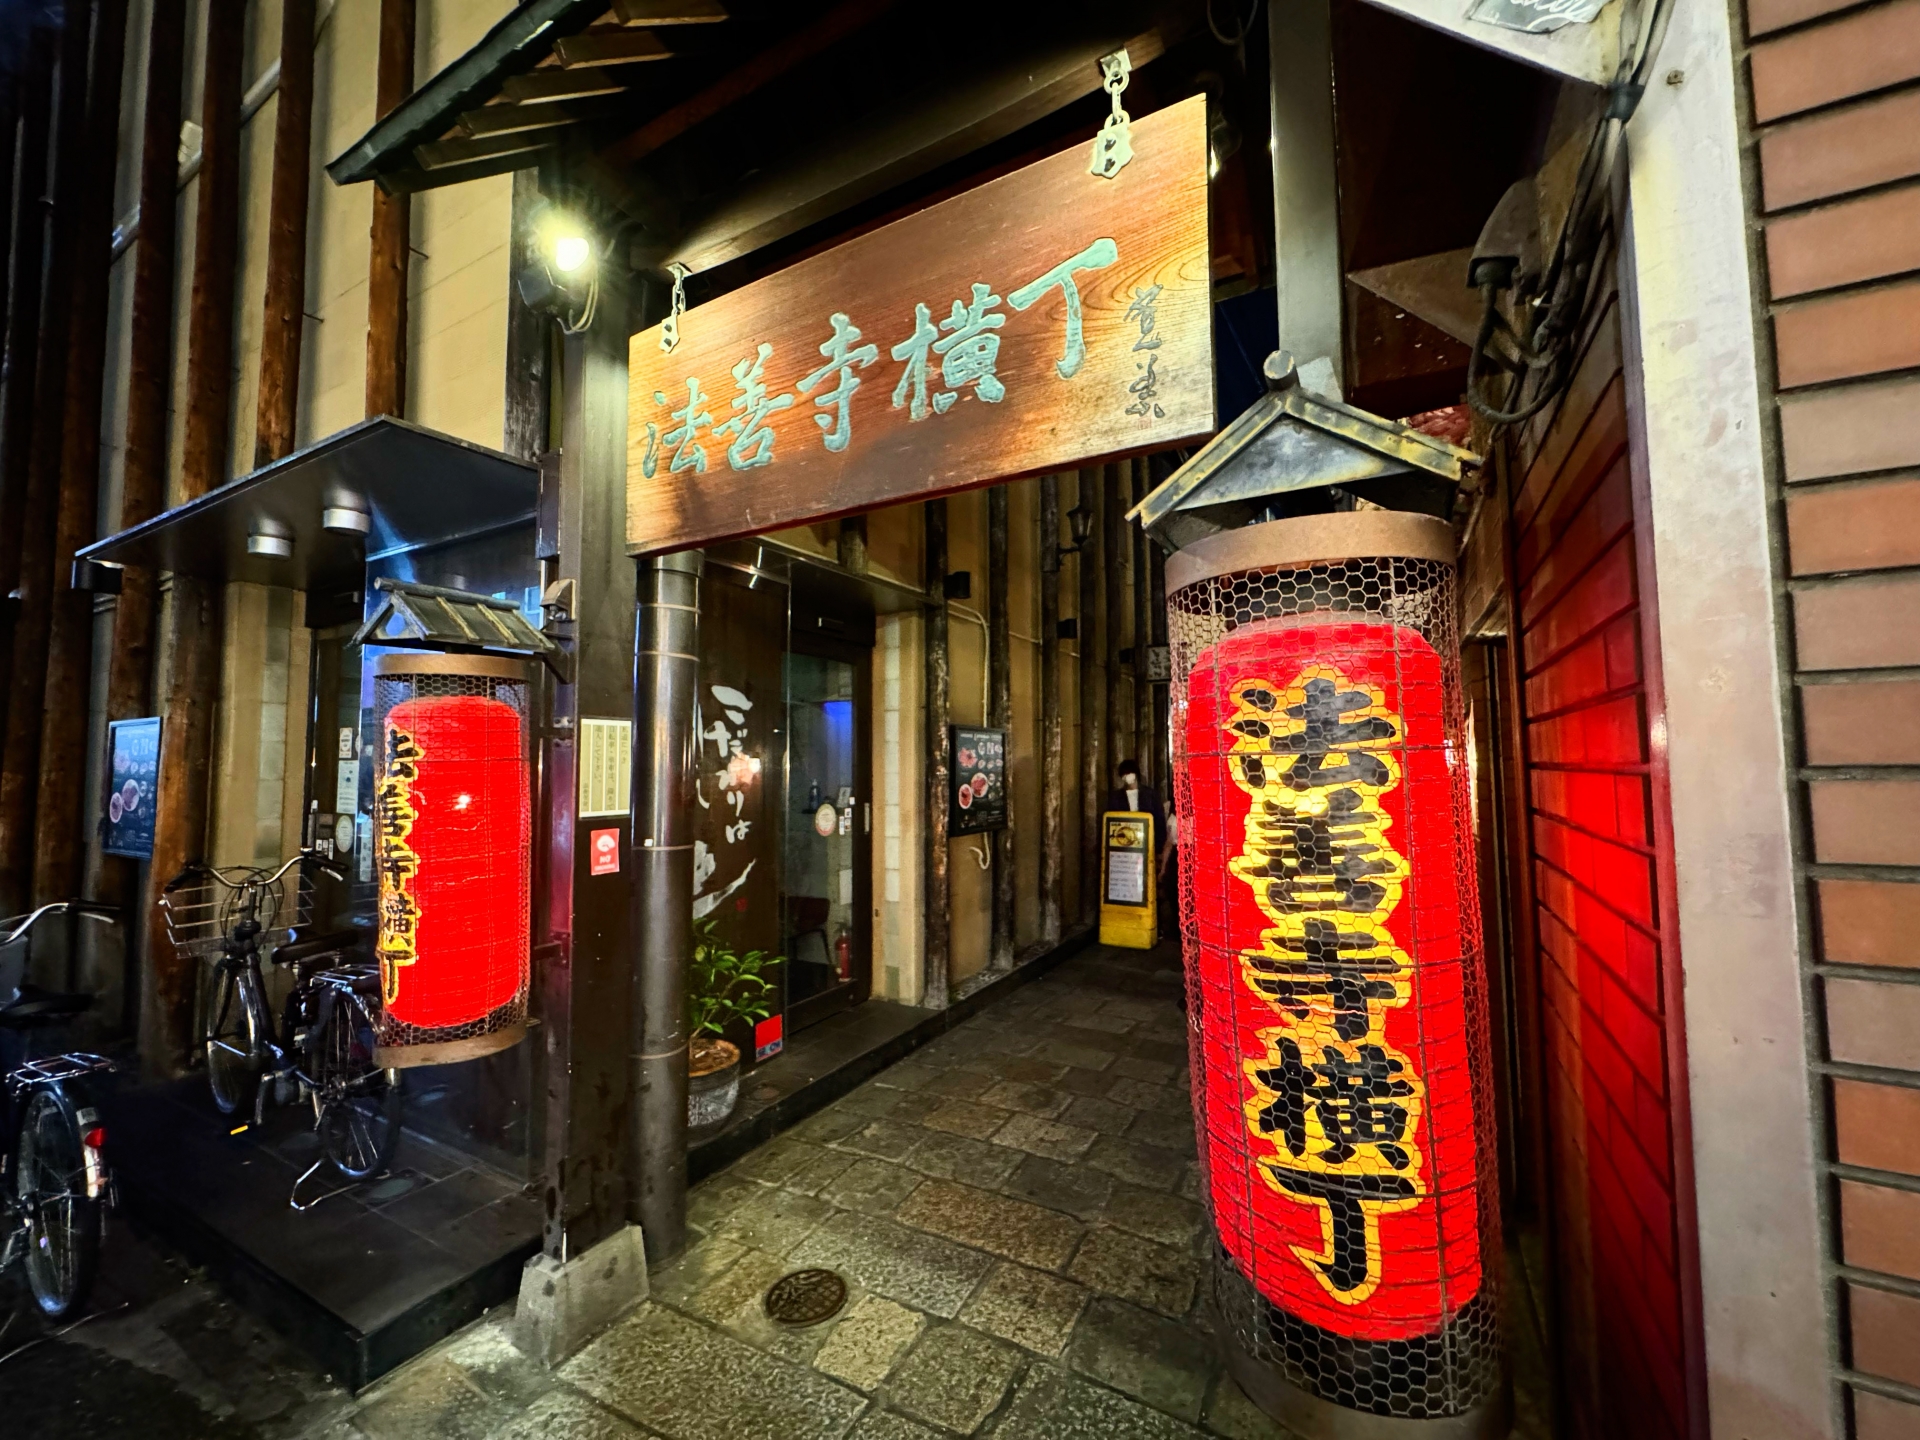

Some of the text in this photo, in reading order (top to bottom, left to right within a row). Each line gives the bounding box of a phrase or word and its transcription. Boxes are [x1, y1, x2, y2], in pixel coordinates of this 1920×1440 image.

[642, 237, 1118, 480] 法善寺横丁
[1234, 677, 1416, 1290] 法善寺横丁
